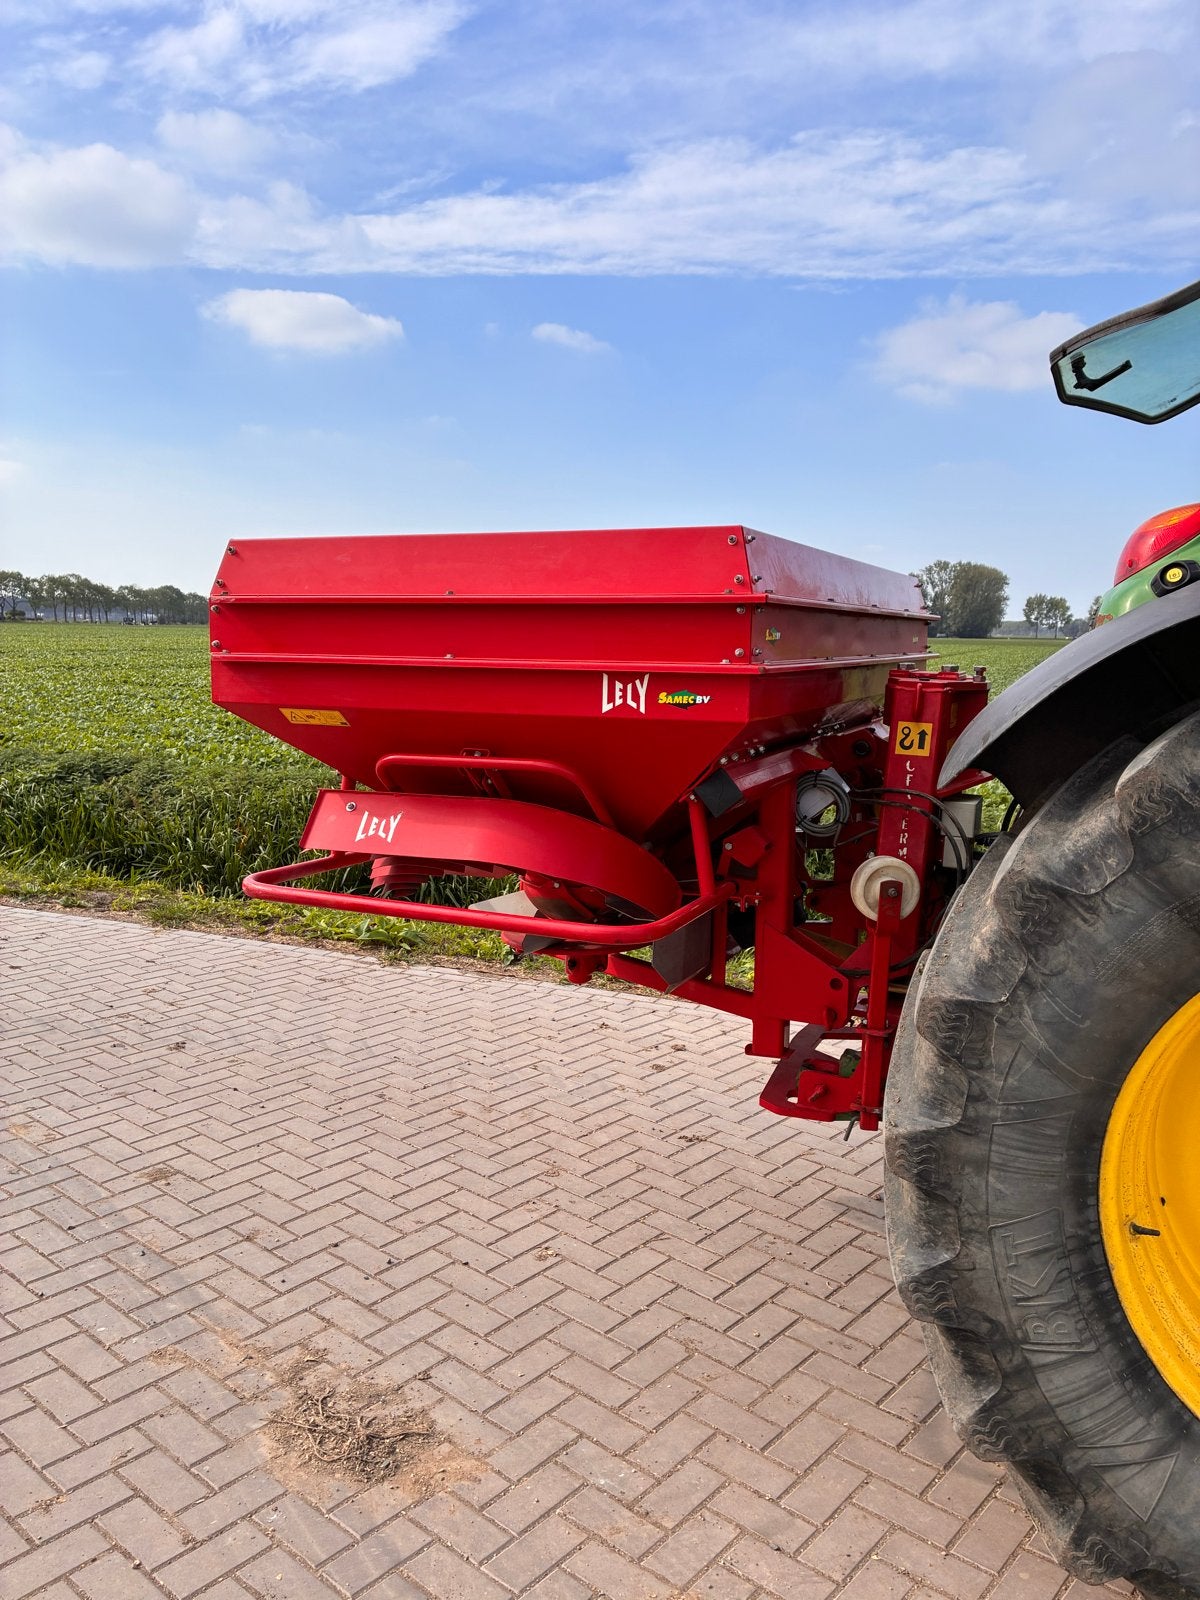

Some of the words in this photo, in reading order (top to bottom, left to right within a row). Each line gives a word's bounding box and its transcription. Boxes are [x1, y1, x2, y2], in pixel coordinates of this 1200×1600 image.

[601, 672, 650, 714] LELY
[657, 691, 695, 704] SAMEC
[695, 695, 711, 704] BV
[354, 810, 403, 843] LELY
[1001, 1230, 1081, 1343] BKT
